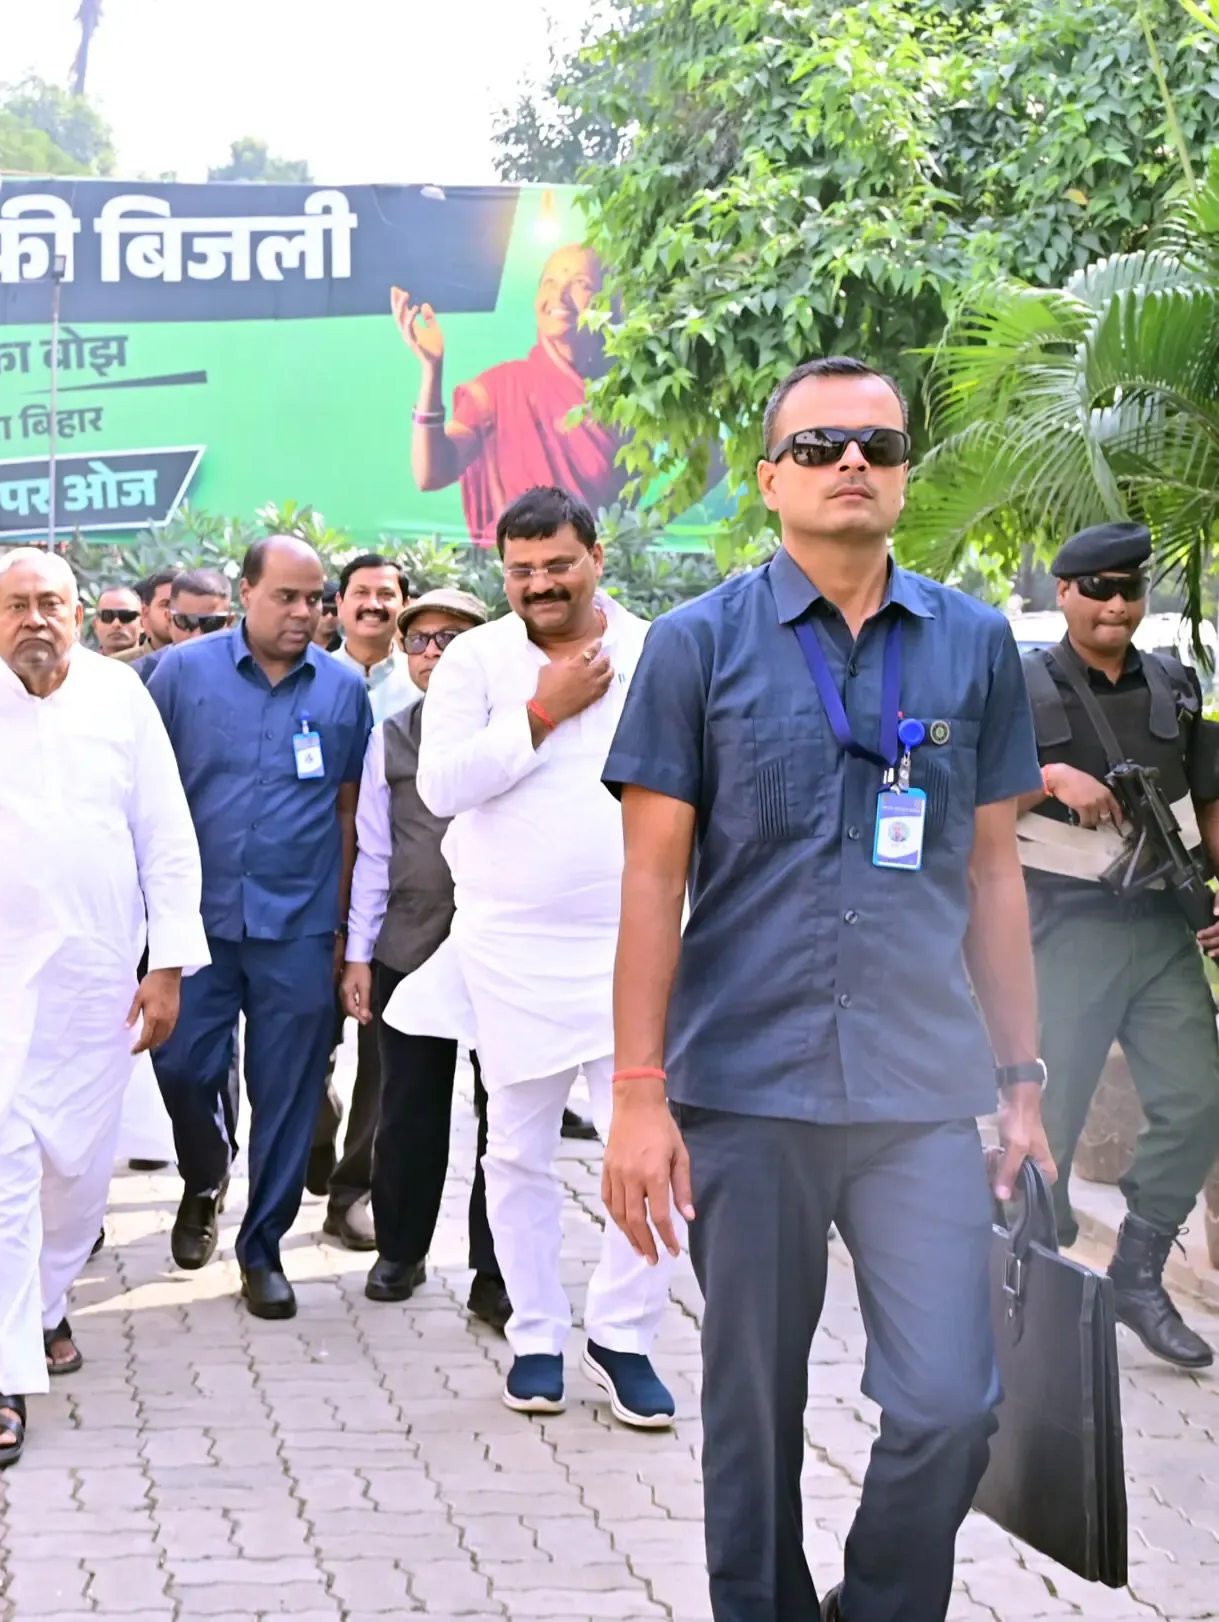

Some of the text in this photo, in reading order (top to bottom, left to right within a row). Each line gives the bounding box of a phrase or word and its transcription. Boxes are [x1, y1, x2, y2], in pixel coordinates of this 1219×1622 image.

[94, 190, 358, 283] बिजली
[39, 326, 128, 377] बोझ
[20, 404, 104, 439] बिहार
[63, 460, 158, 511] ओज
